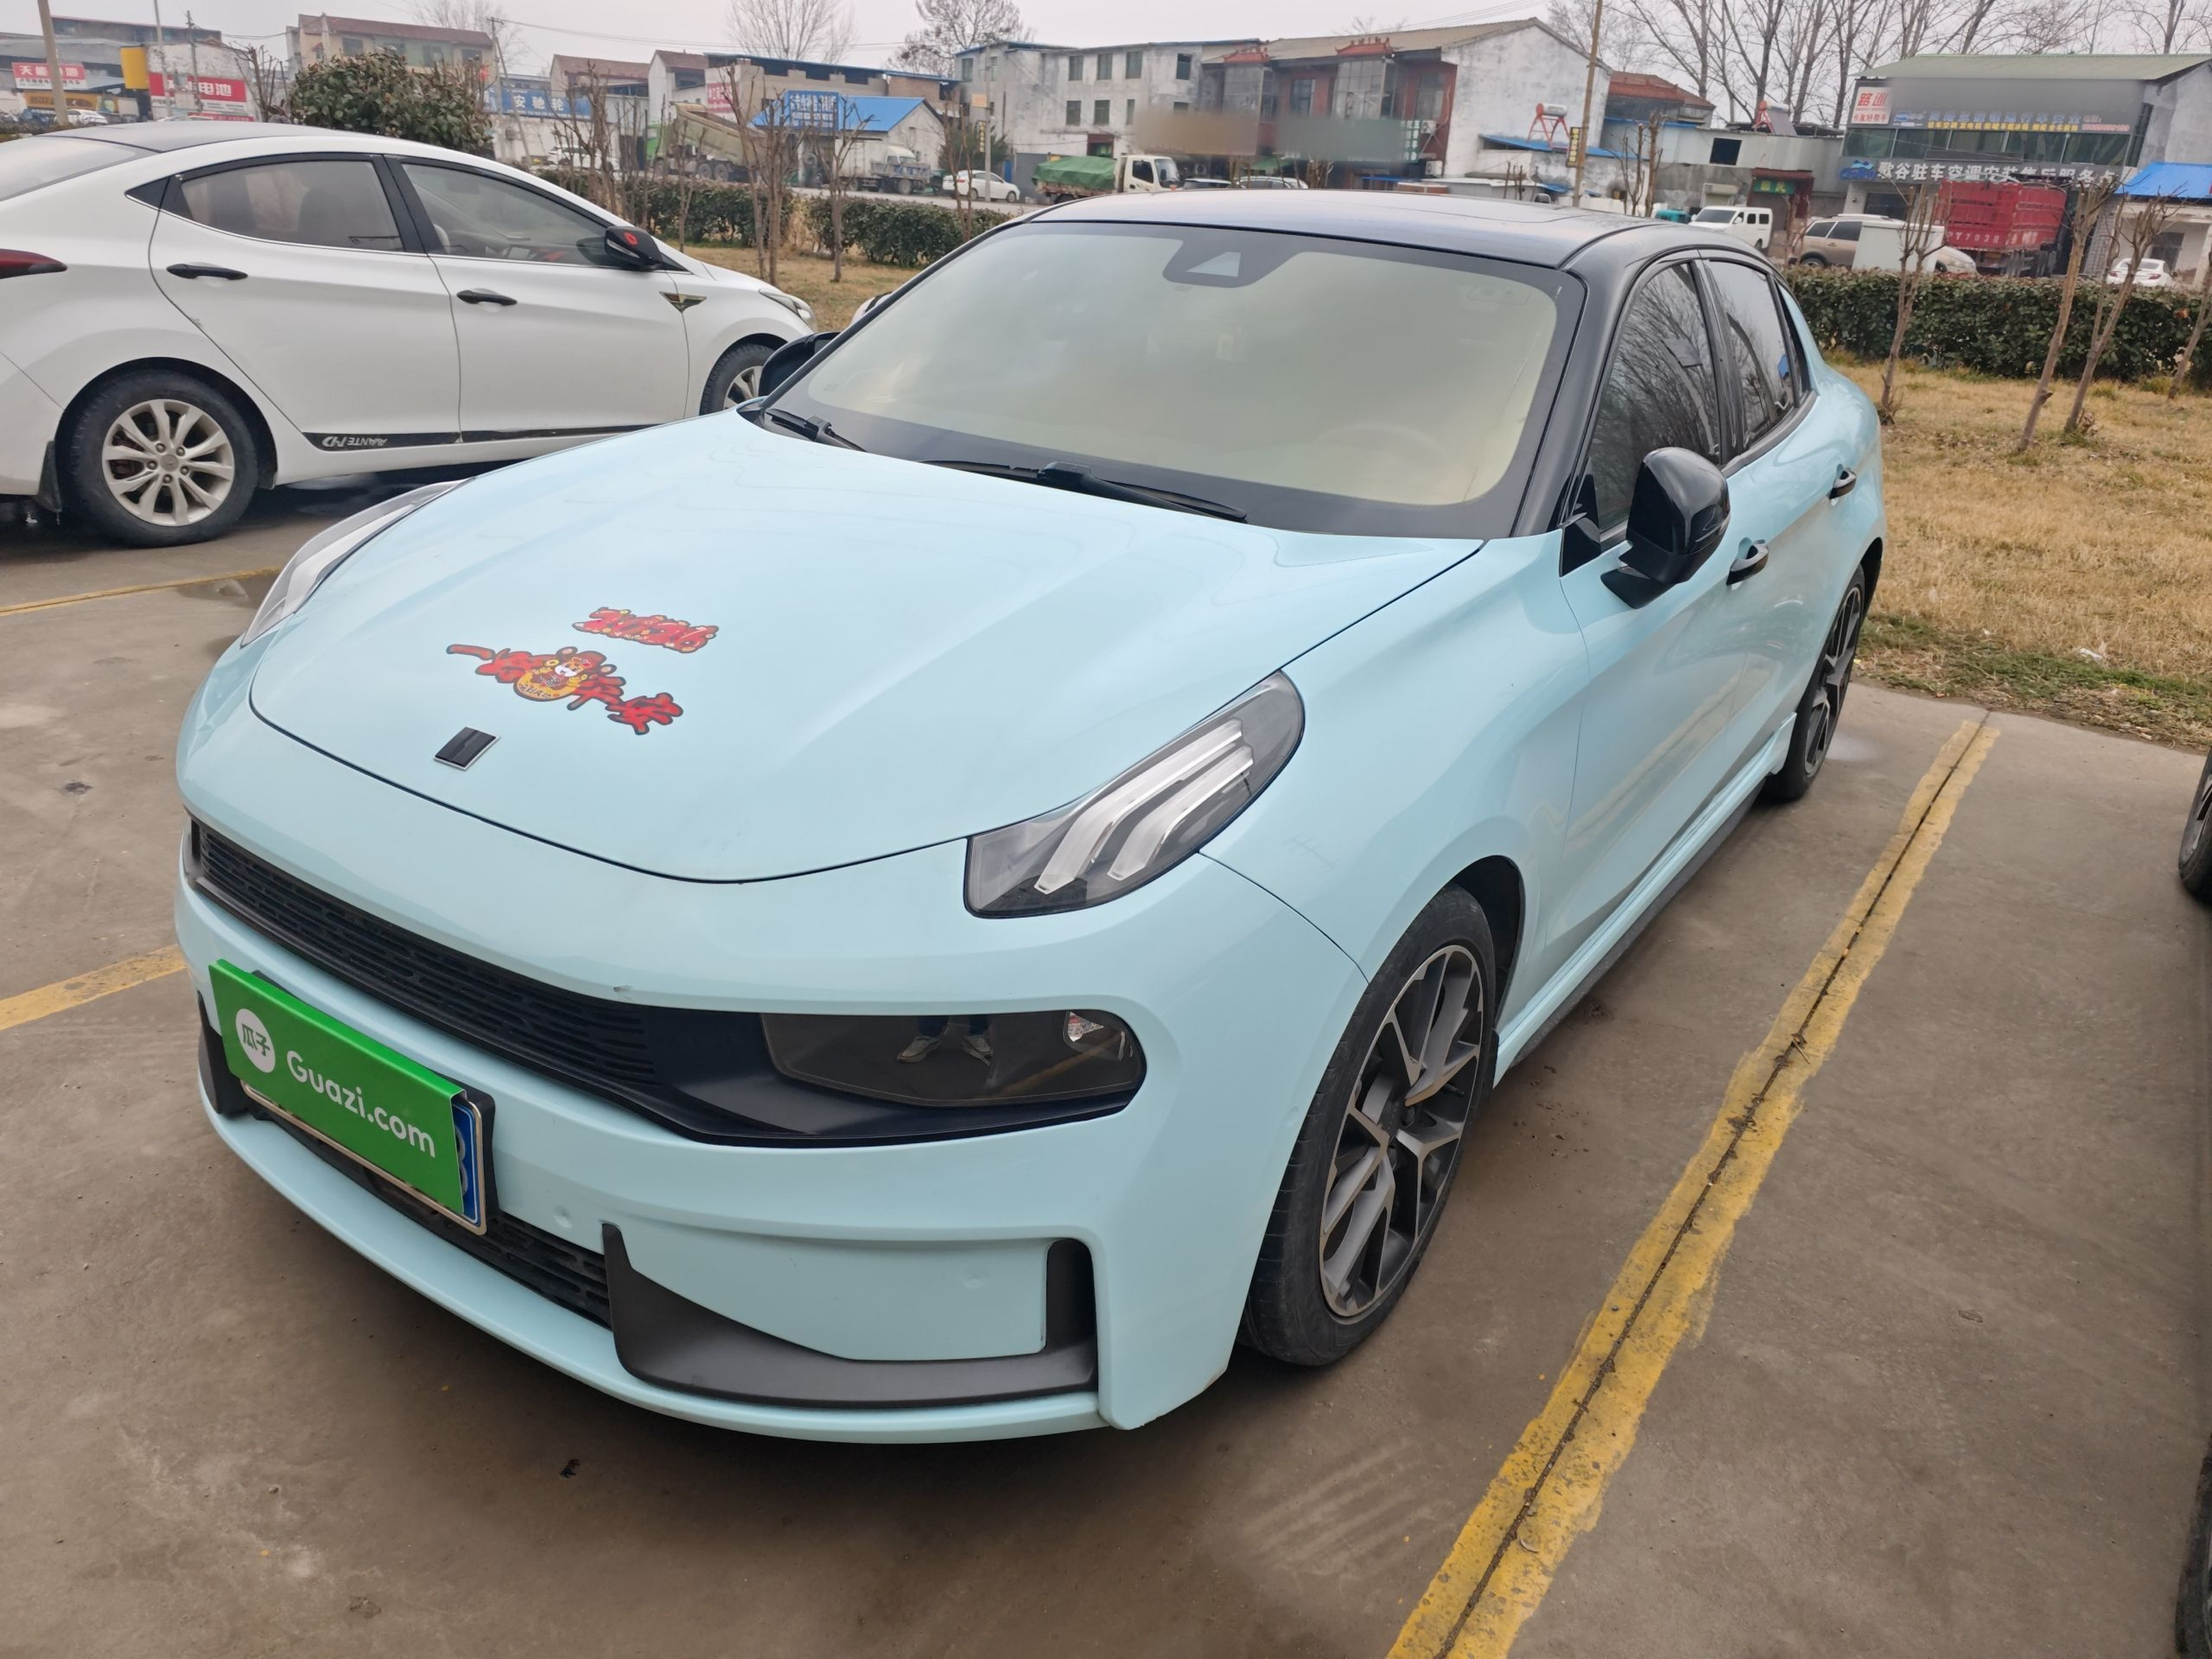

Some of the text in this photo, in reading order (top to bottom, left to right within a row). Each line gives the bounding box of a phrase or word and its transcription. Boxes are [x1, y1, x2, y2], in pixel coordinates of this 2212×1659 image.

[20, 65, 79, 77] 天能池
[241, 1023, 271, 1056] 瓜子
[286, 1050, 435, 1158] Guazi.com
